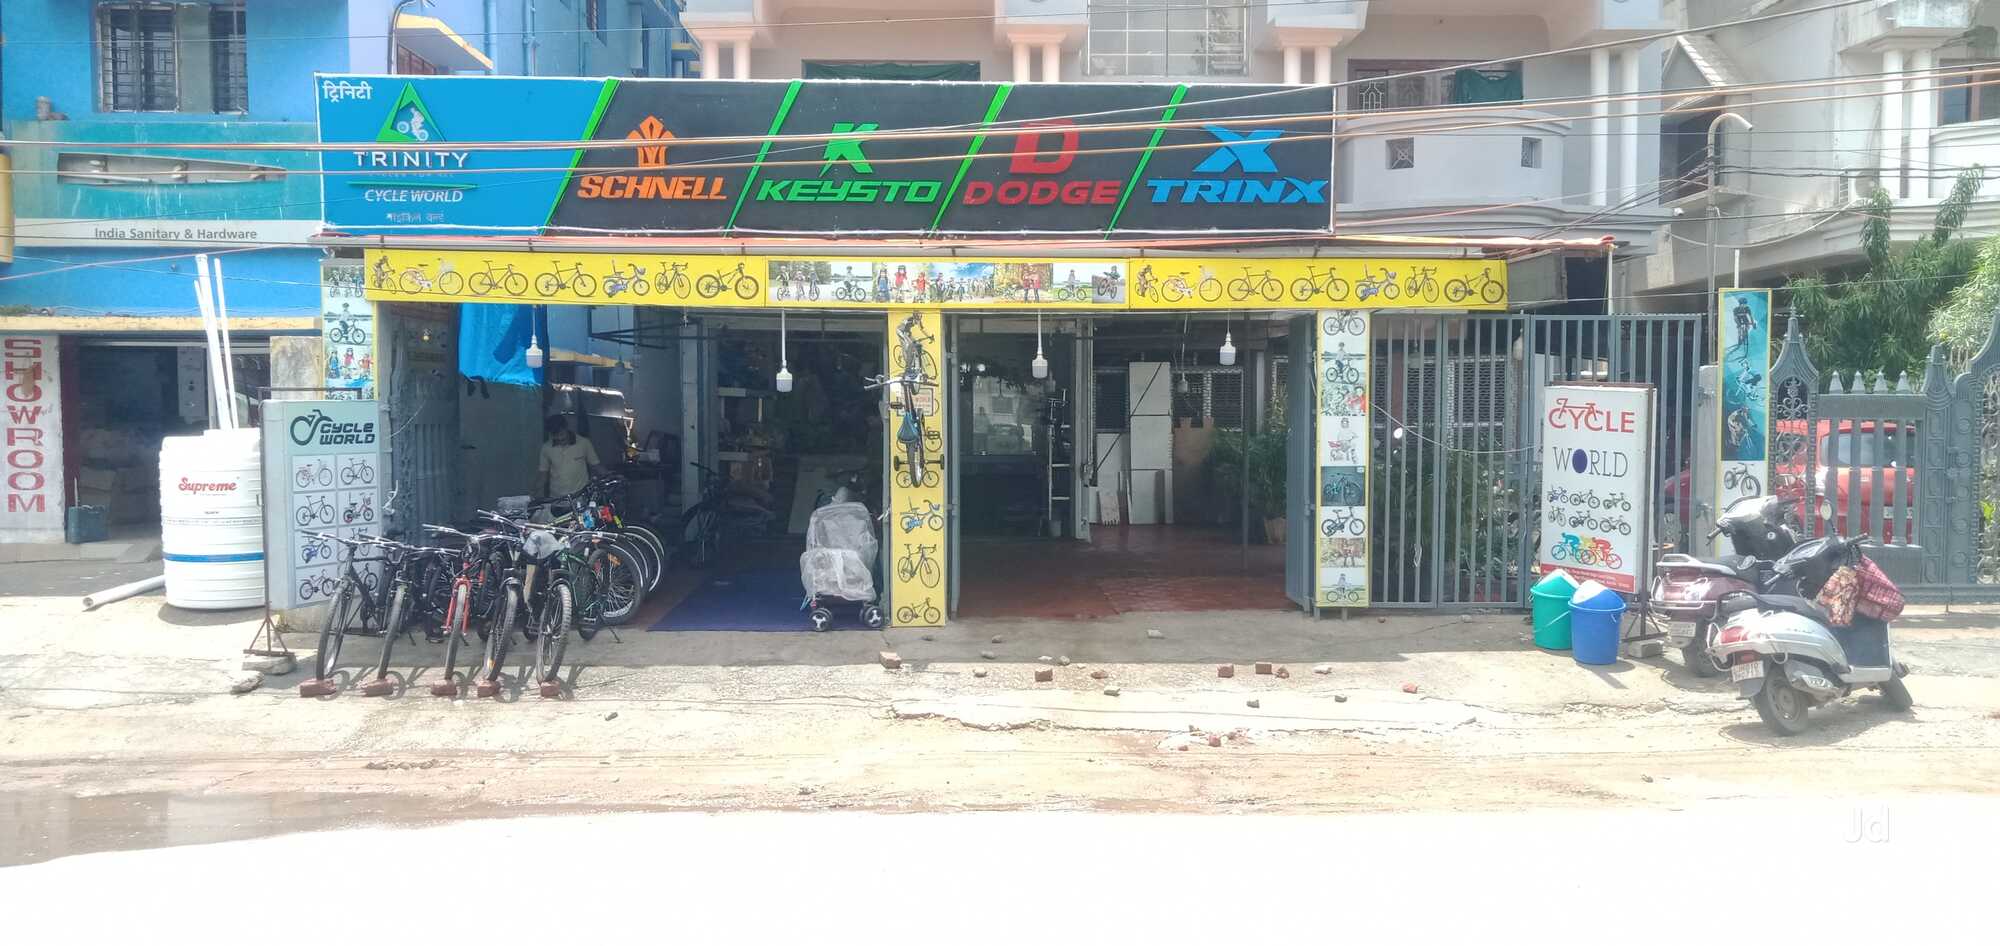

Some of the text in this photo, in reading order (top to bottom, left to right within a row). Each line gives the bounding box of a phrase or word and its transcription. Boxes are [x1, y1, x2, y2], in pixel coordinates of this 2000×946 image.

[322, 80, 374, 102] ट्रिनिटी
[818, 122, 881, 177] K
[1009, 118, 1080, 174] D
[353, 150, 469, 169] TRINITY
[364, 189, 464, 203] CYCLE WORLD
[576, 175, 728, 200] SCHNELL
[756, 180, 943, 203] KEYSTO
[962, 180, 1121, 205] DODGE
[1147, 177, 1329, 204] TRINX
[94, 227, 258, 240] India Sanitary & Hardware
[4, 338, 46, 513] SHOWROOM
[320, 422, 375, 434] CYCLE
[1548, 406, 1636, 433] CYCLE
[319, 433, 376, 446] WORLD
[1552, 446, 1629, 478] WORLD
[178, 476, 238, 495] Supreme
